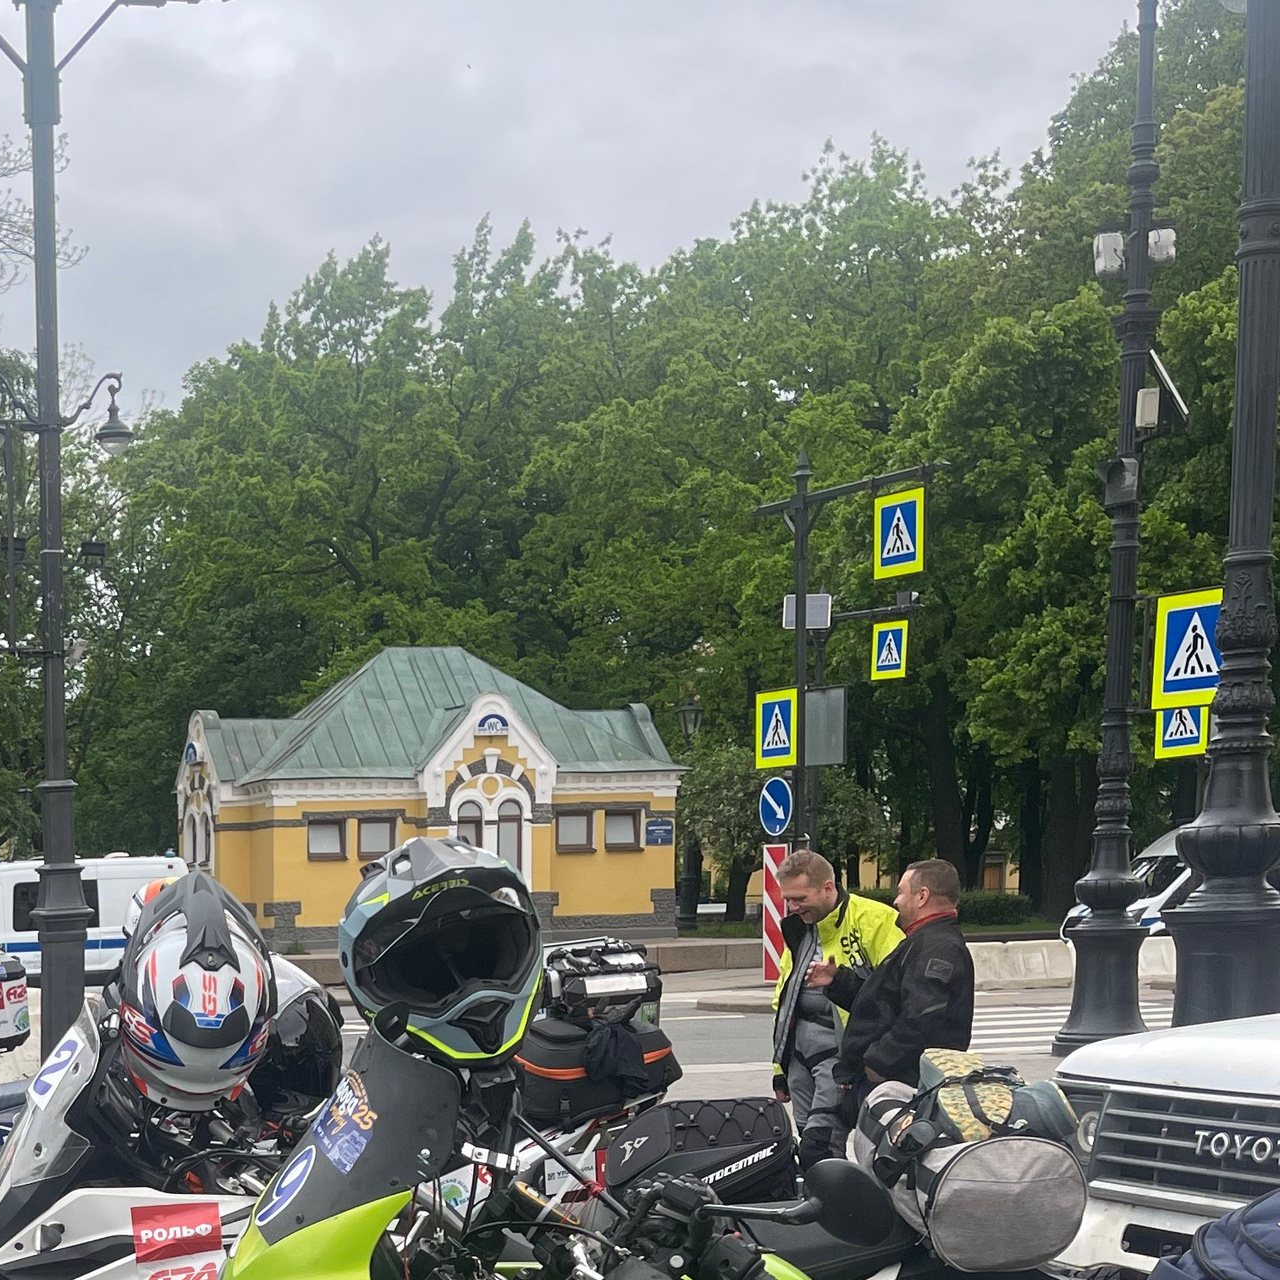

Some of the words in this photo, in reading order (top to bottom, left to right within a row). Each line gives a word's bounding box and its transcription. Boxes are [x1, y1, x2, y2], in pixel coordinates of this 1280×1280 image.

[487, 721, 500, 731] WC
[412, 878, 470, 900] ACERBIS
[33, 1039, 78, 1095] 2
[701, 1145, 774, 1184] OTOCENTRIC
[1194, 1129, 1280, 1166] TOYO
[255, 1145, 316, 1226] 9
[140, 1223, 213, 1244] РОЛЬФ
